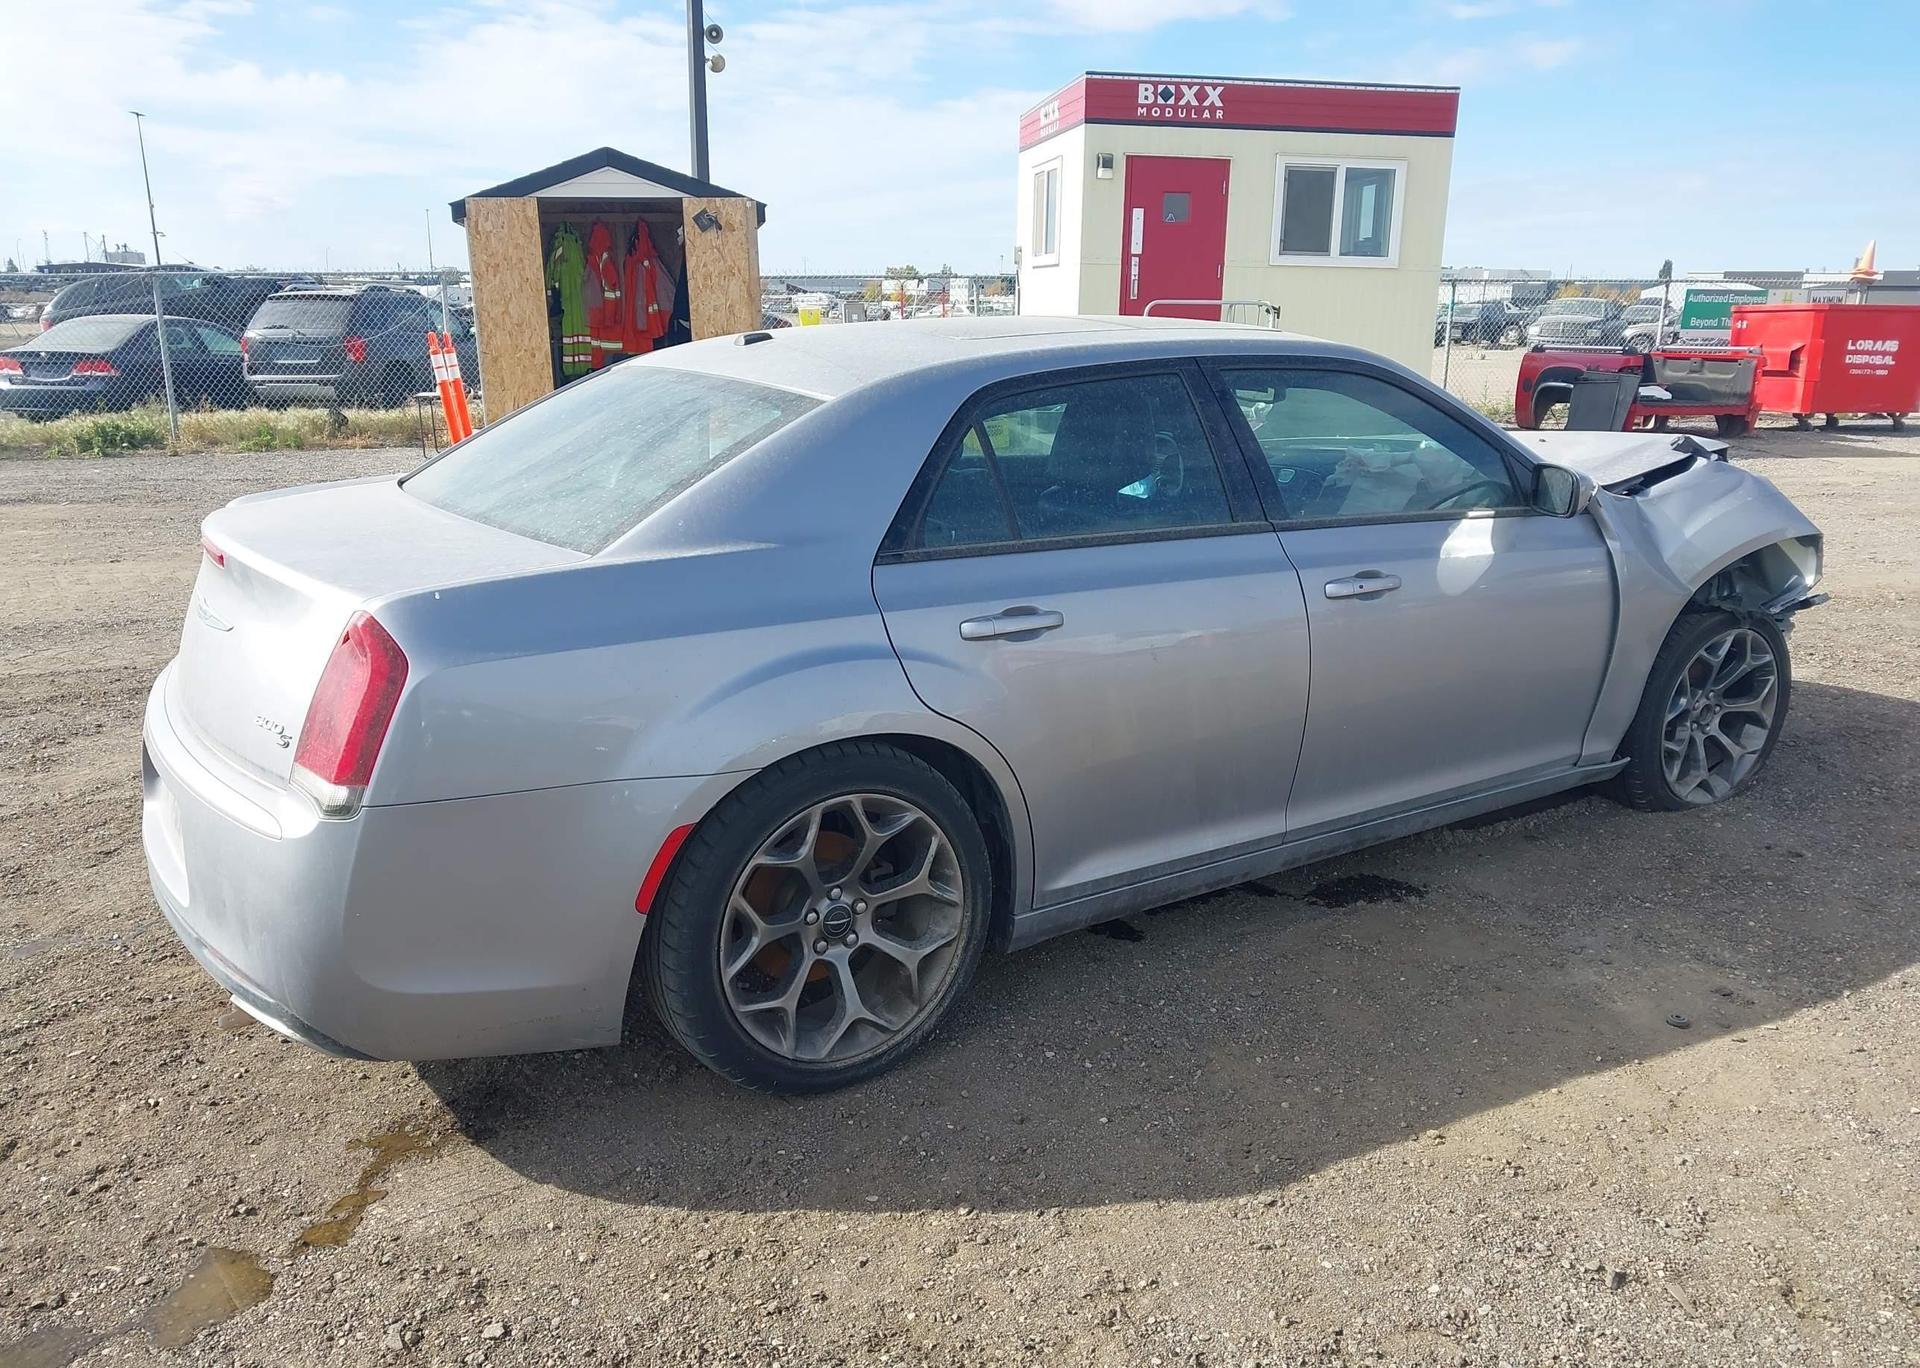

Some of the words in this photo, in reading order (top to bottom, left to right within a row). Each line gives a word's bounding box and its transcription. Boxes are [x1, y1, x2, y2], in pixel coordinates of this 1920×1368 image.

[1137, 106, 1225, 120] MODULAR
[1688, 292, 1729, 303] Authorized
[1729, 293, 1768, 305] Employees
[1812, 295, 1844, 304] MAXIMUM
[1690, 316, 1719, 329] Beyond
[1846, 339, 1899, 352] LORAAS
[1845, 354, 1896, 365] DISPOSAL
